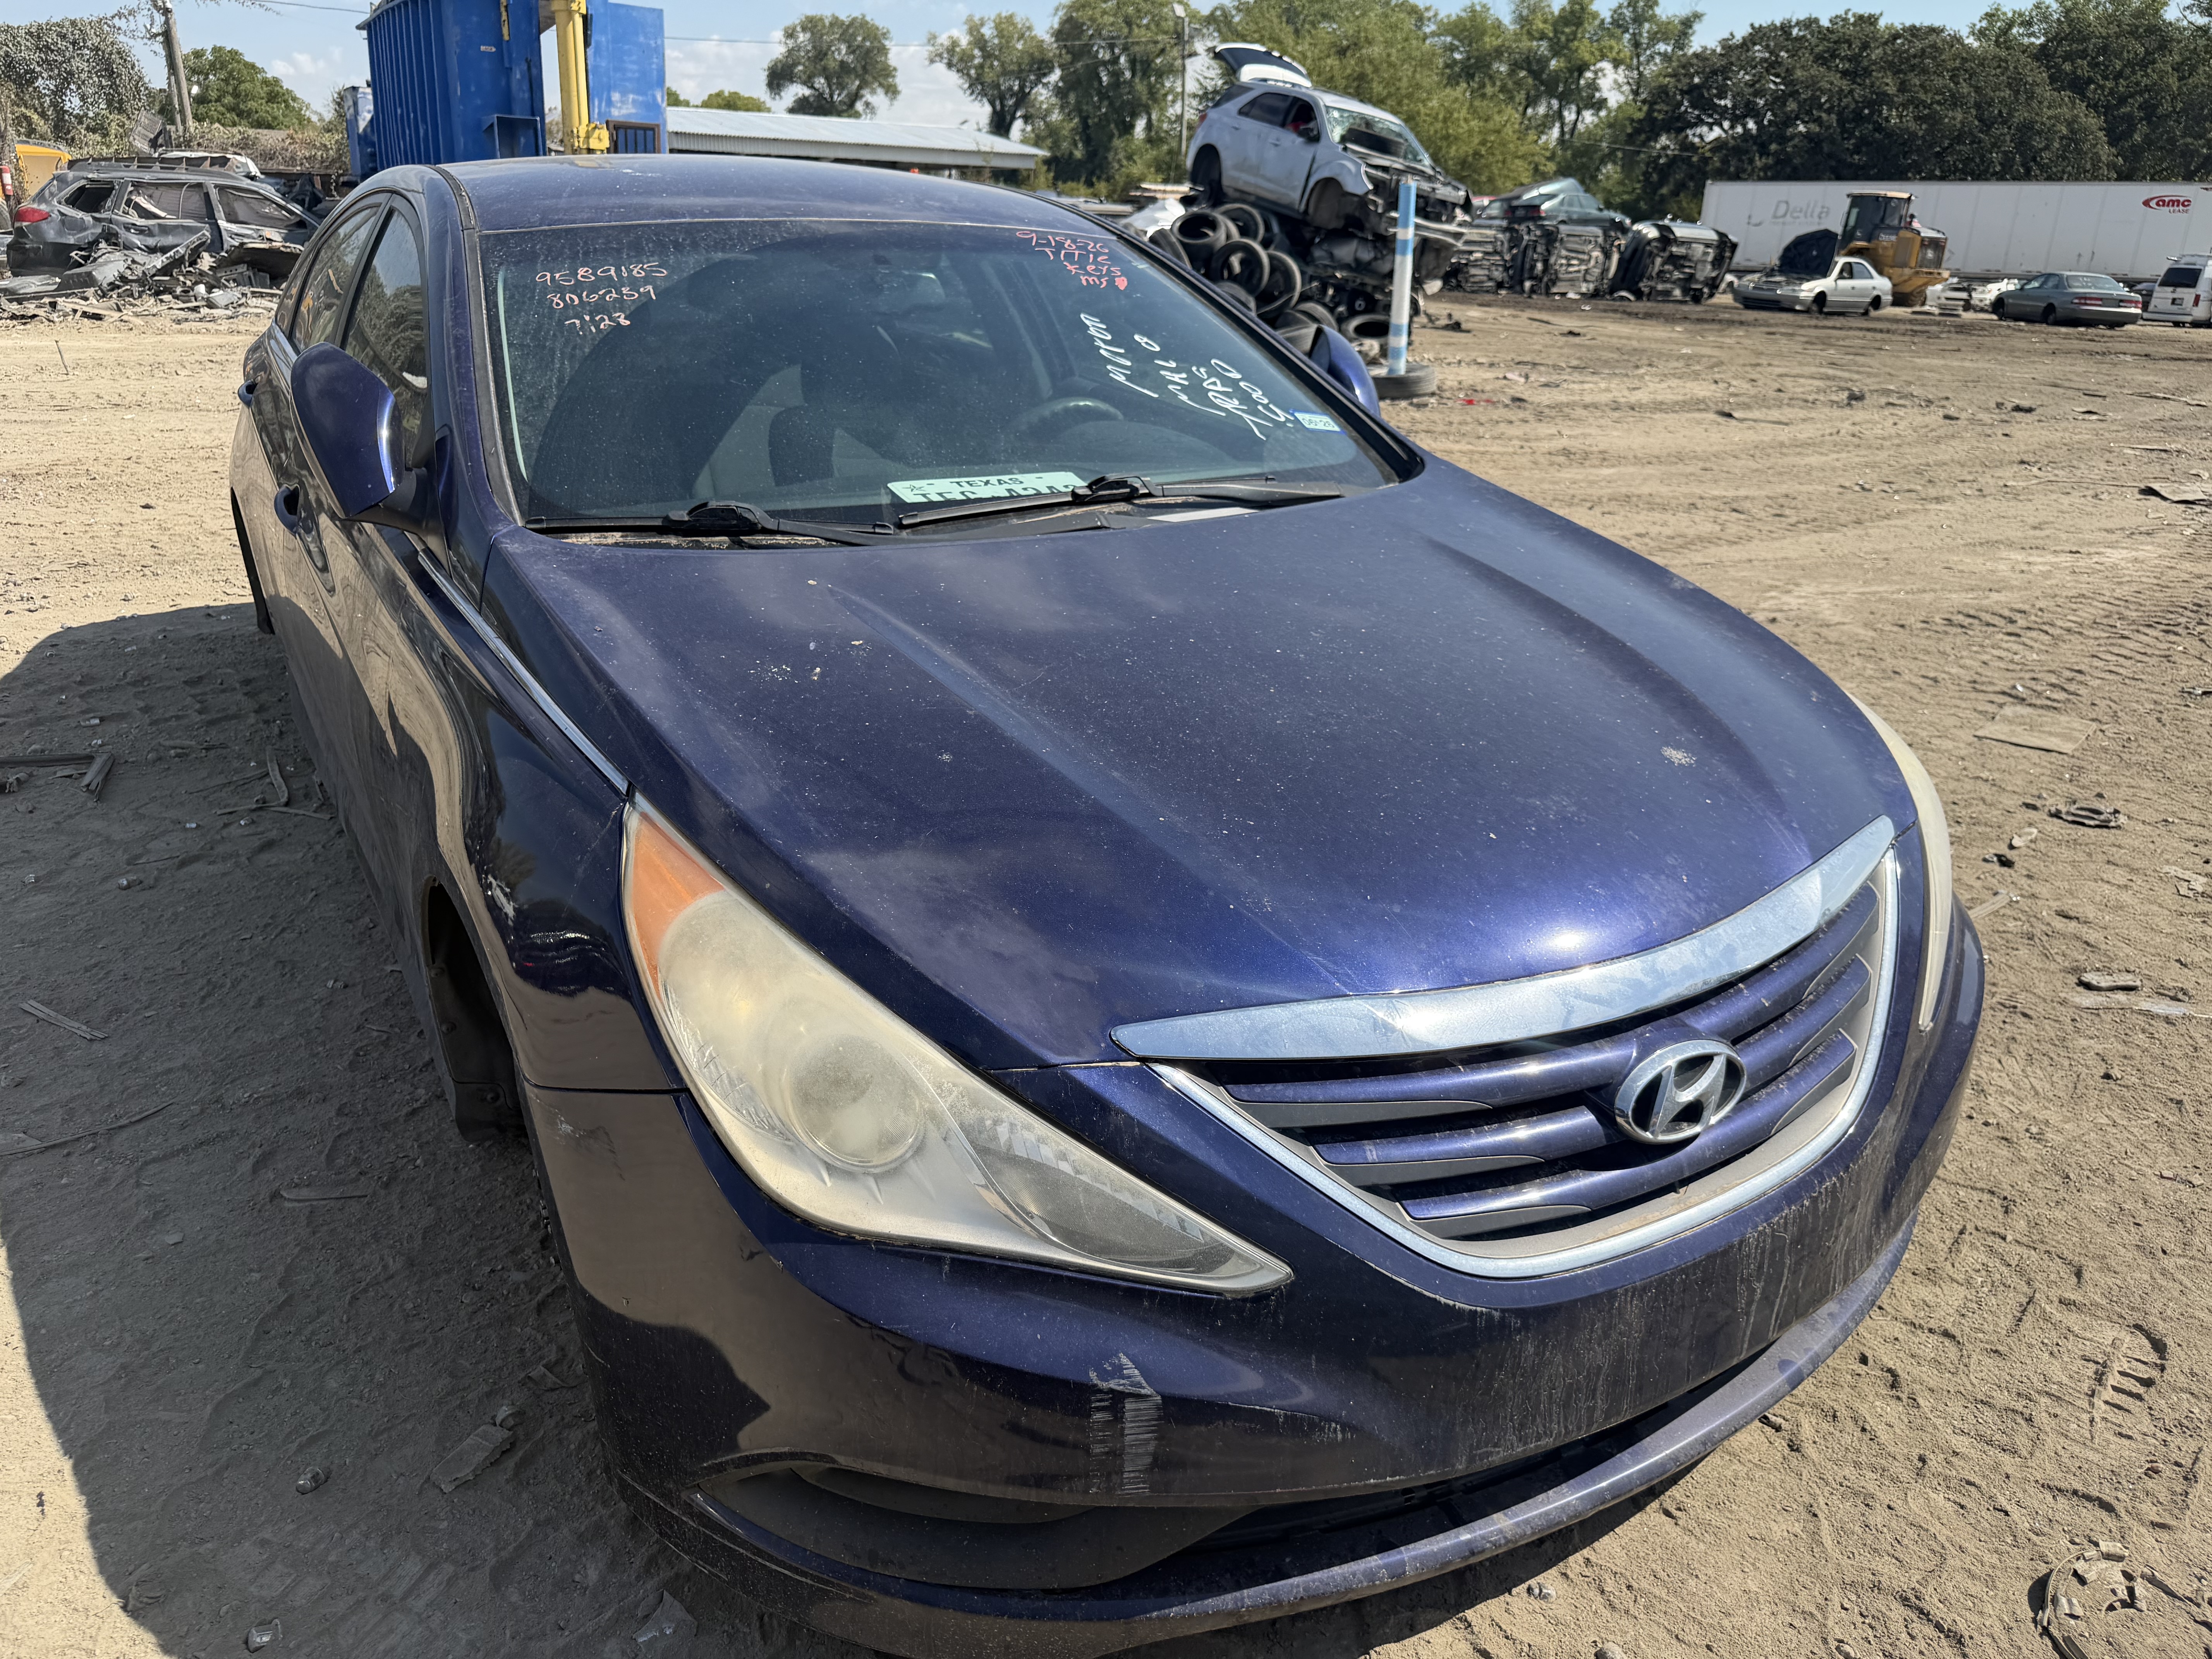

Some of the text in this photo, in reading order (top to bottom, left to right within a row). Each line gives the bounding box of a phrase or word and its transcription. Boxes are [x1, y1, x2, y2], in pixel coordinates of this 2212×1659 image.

[2155, 199, 2192, 208] amc
[536, 262, 668, 286] 9589185
[950, 477, 1024, 488] TEXAS
